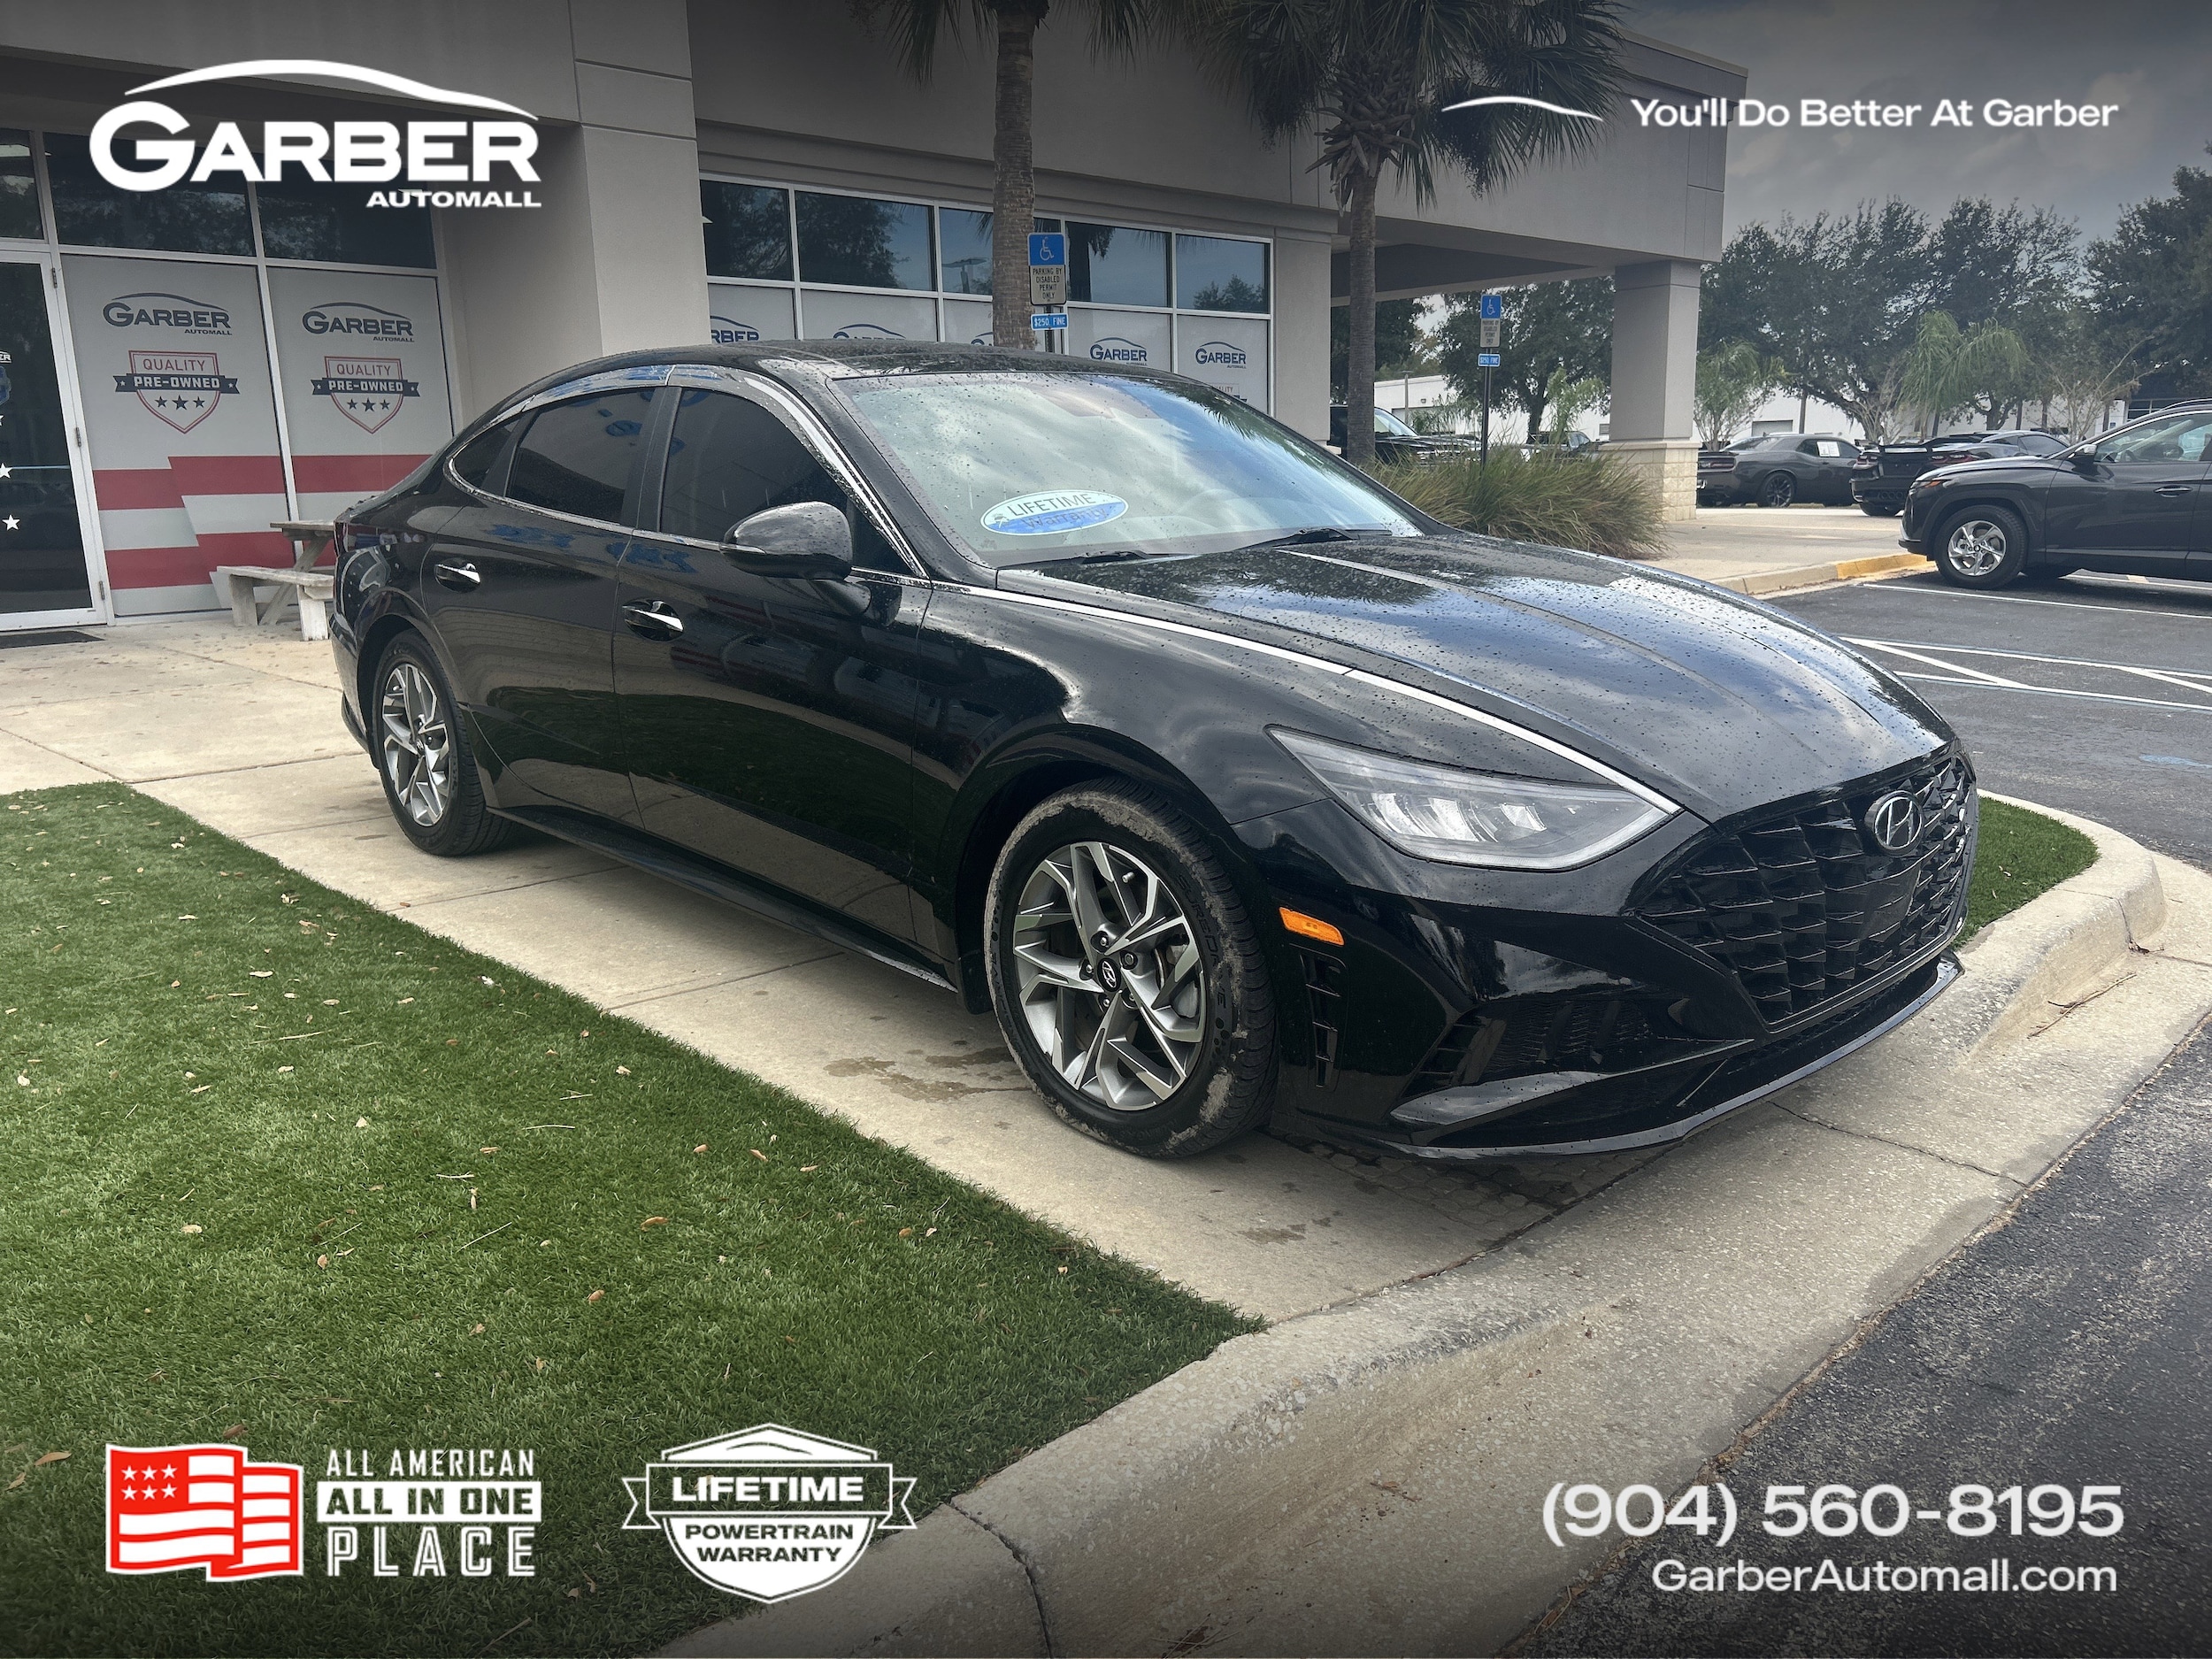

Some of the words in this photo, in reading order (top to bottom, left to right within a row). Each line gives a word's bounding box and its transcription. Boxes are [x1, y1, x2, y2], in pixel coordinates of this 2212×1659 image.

[103, 302, 231, 328] GARBER
[1053, 316, 1066, 326] FINE
[302, 311, 413, 335] GARBER
[710, 329, 760, 343] RBER
[1089, 344, 1148, 361] GARBER
[1195, 348, 1247, 365] GARBER
[142, 358, 206, 372] QUALITY
[336, 364, 391, 376] QUALITY
[134, 375, 220, 388] PRE-OWNED
[328, 380, 403, 392] PRE-OWNED
[1007, 494, 1097, 517] LIFETIME
[1021, 508, 1108, 529] Warranty
